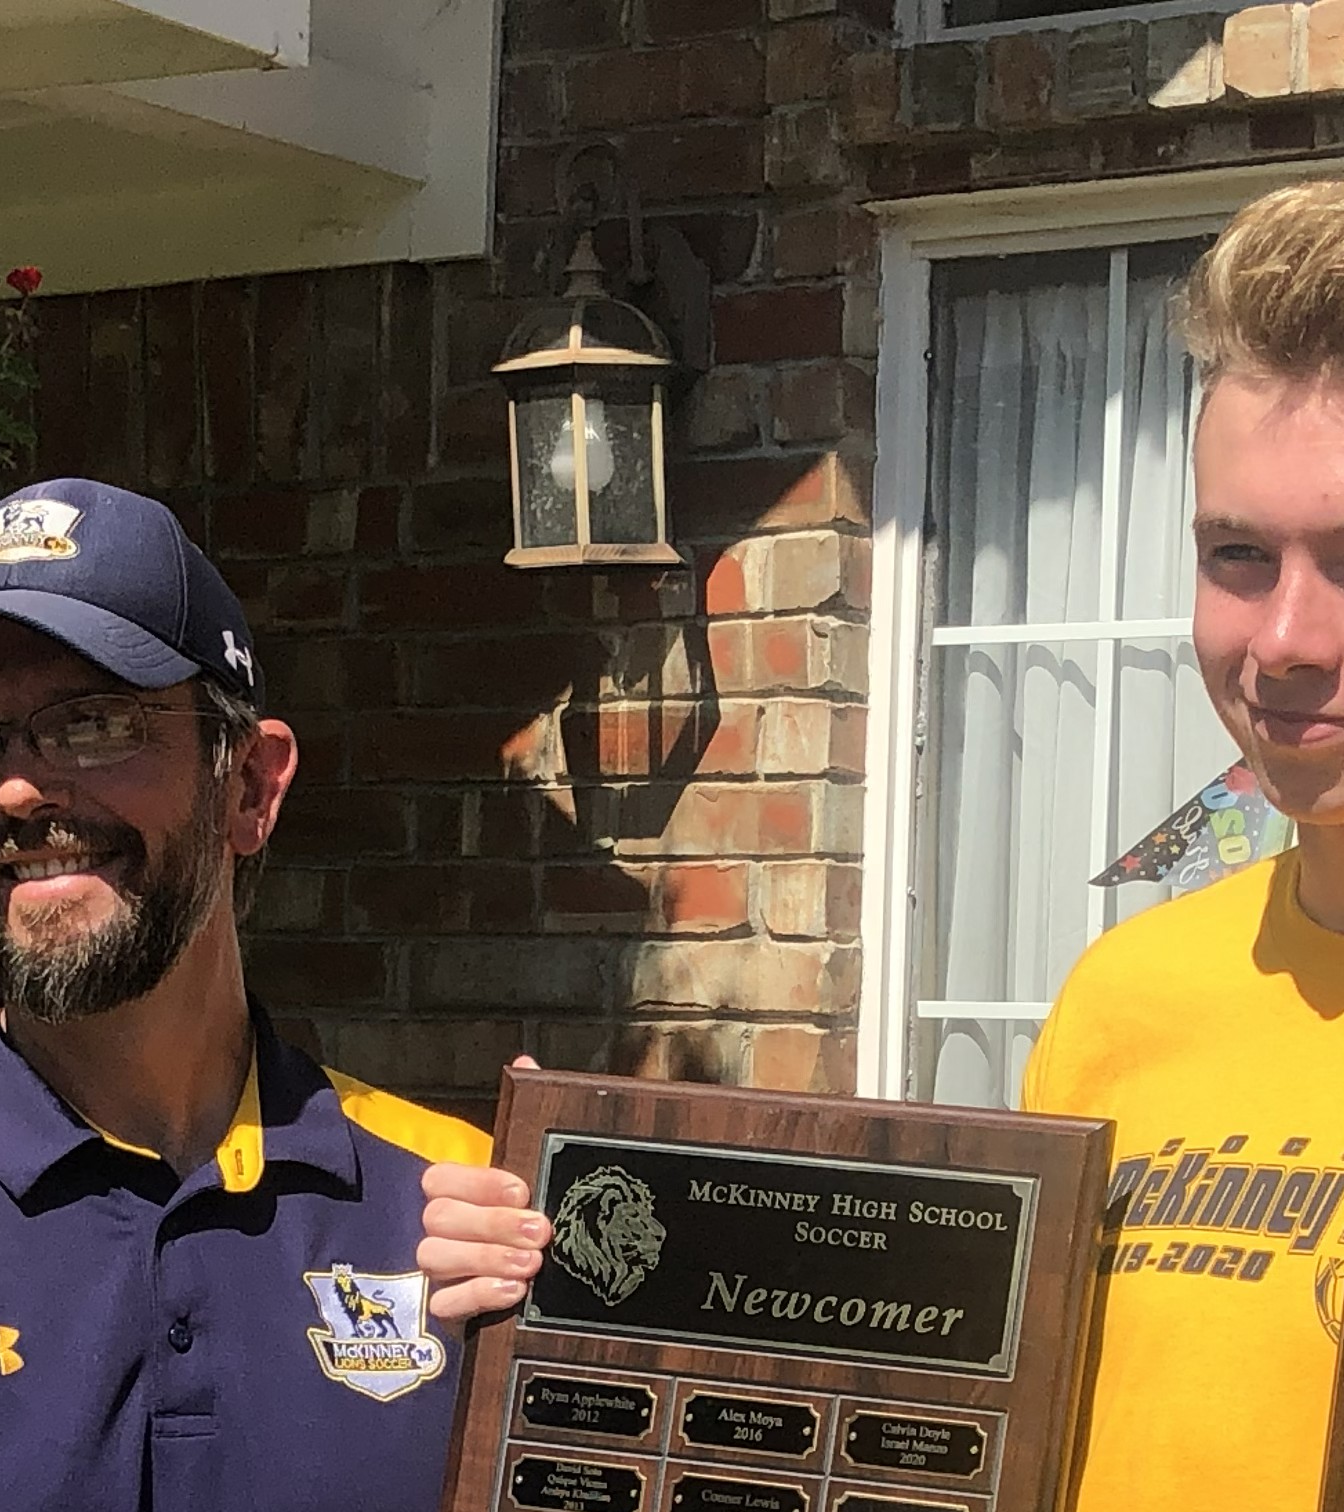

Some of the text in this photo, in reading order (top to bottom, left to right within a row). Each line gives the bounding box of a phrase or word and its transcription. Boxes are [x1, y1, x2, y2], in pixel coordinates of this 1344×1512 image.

[700, 1271, 966, 1337] Newcomer
[368, 1358, 412, 1369] SOCCER
[540, 1387, 636, 1411] Ryan Applewhite
[571, 1408, 600, 1423] 2012
[717, 1408, 783, 1430] Alex Moya
[733, 1426, 763, 1442] 2016
[881, 1422, 952, 1441] Calvin Doyle
[899, 1452, 927, 1466] 2020
